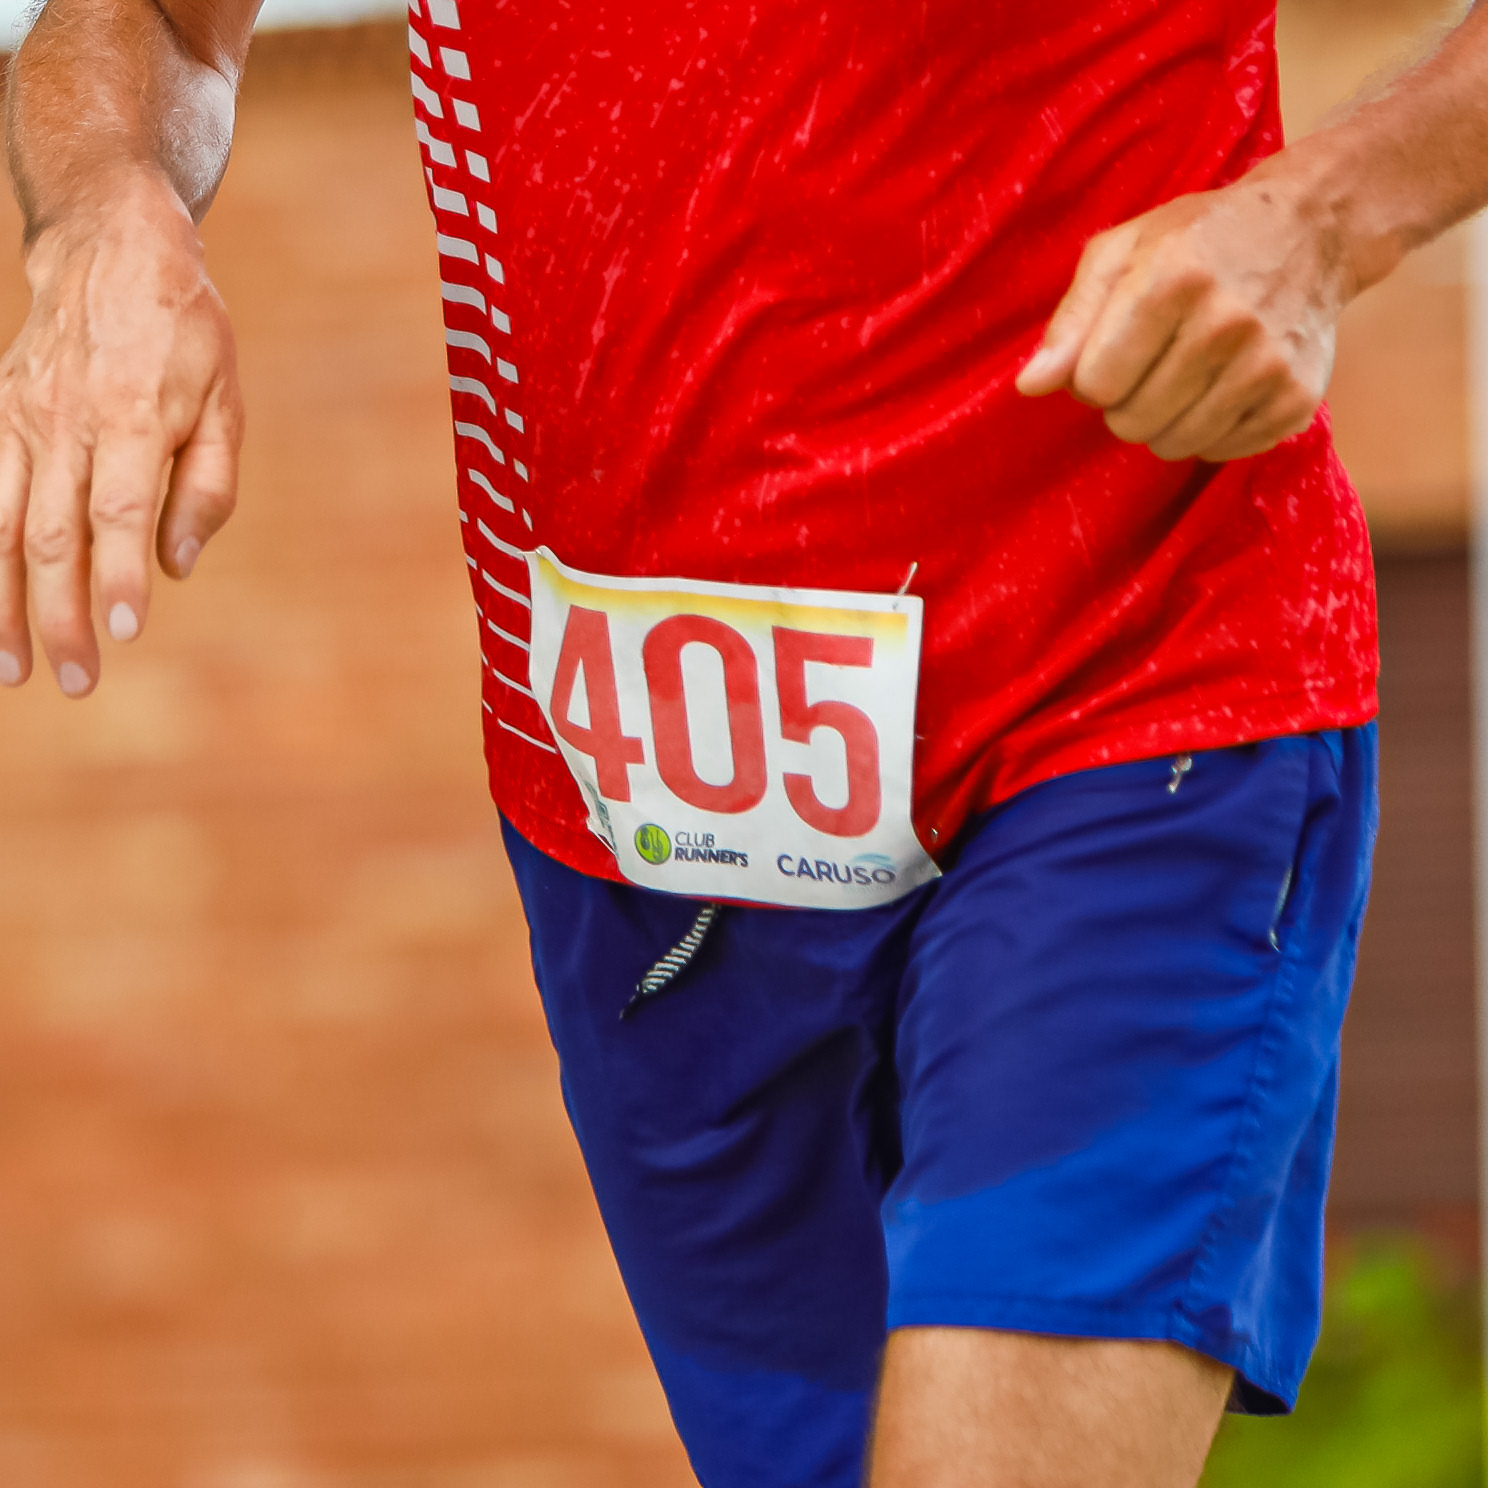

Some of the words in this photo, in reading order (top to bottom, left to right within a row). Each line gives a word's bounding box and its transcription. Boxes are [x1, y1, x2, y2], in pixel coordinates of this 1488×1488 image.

[550, 603, 883, 839] 405
[675, 831, 716, 849] CLUB
[776, 853, 896, 885] CARUSO
